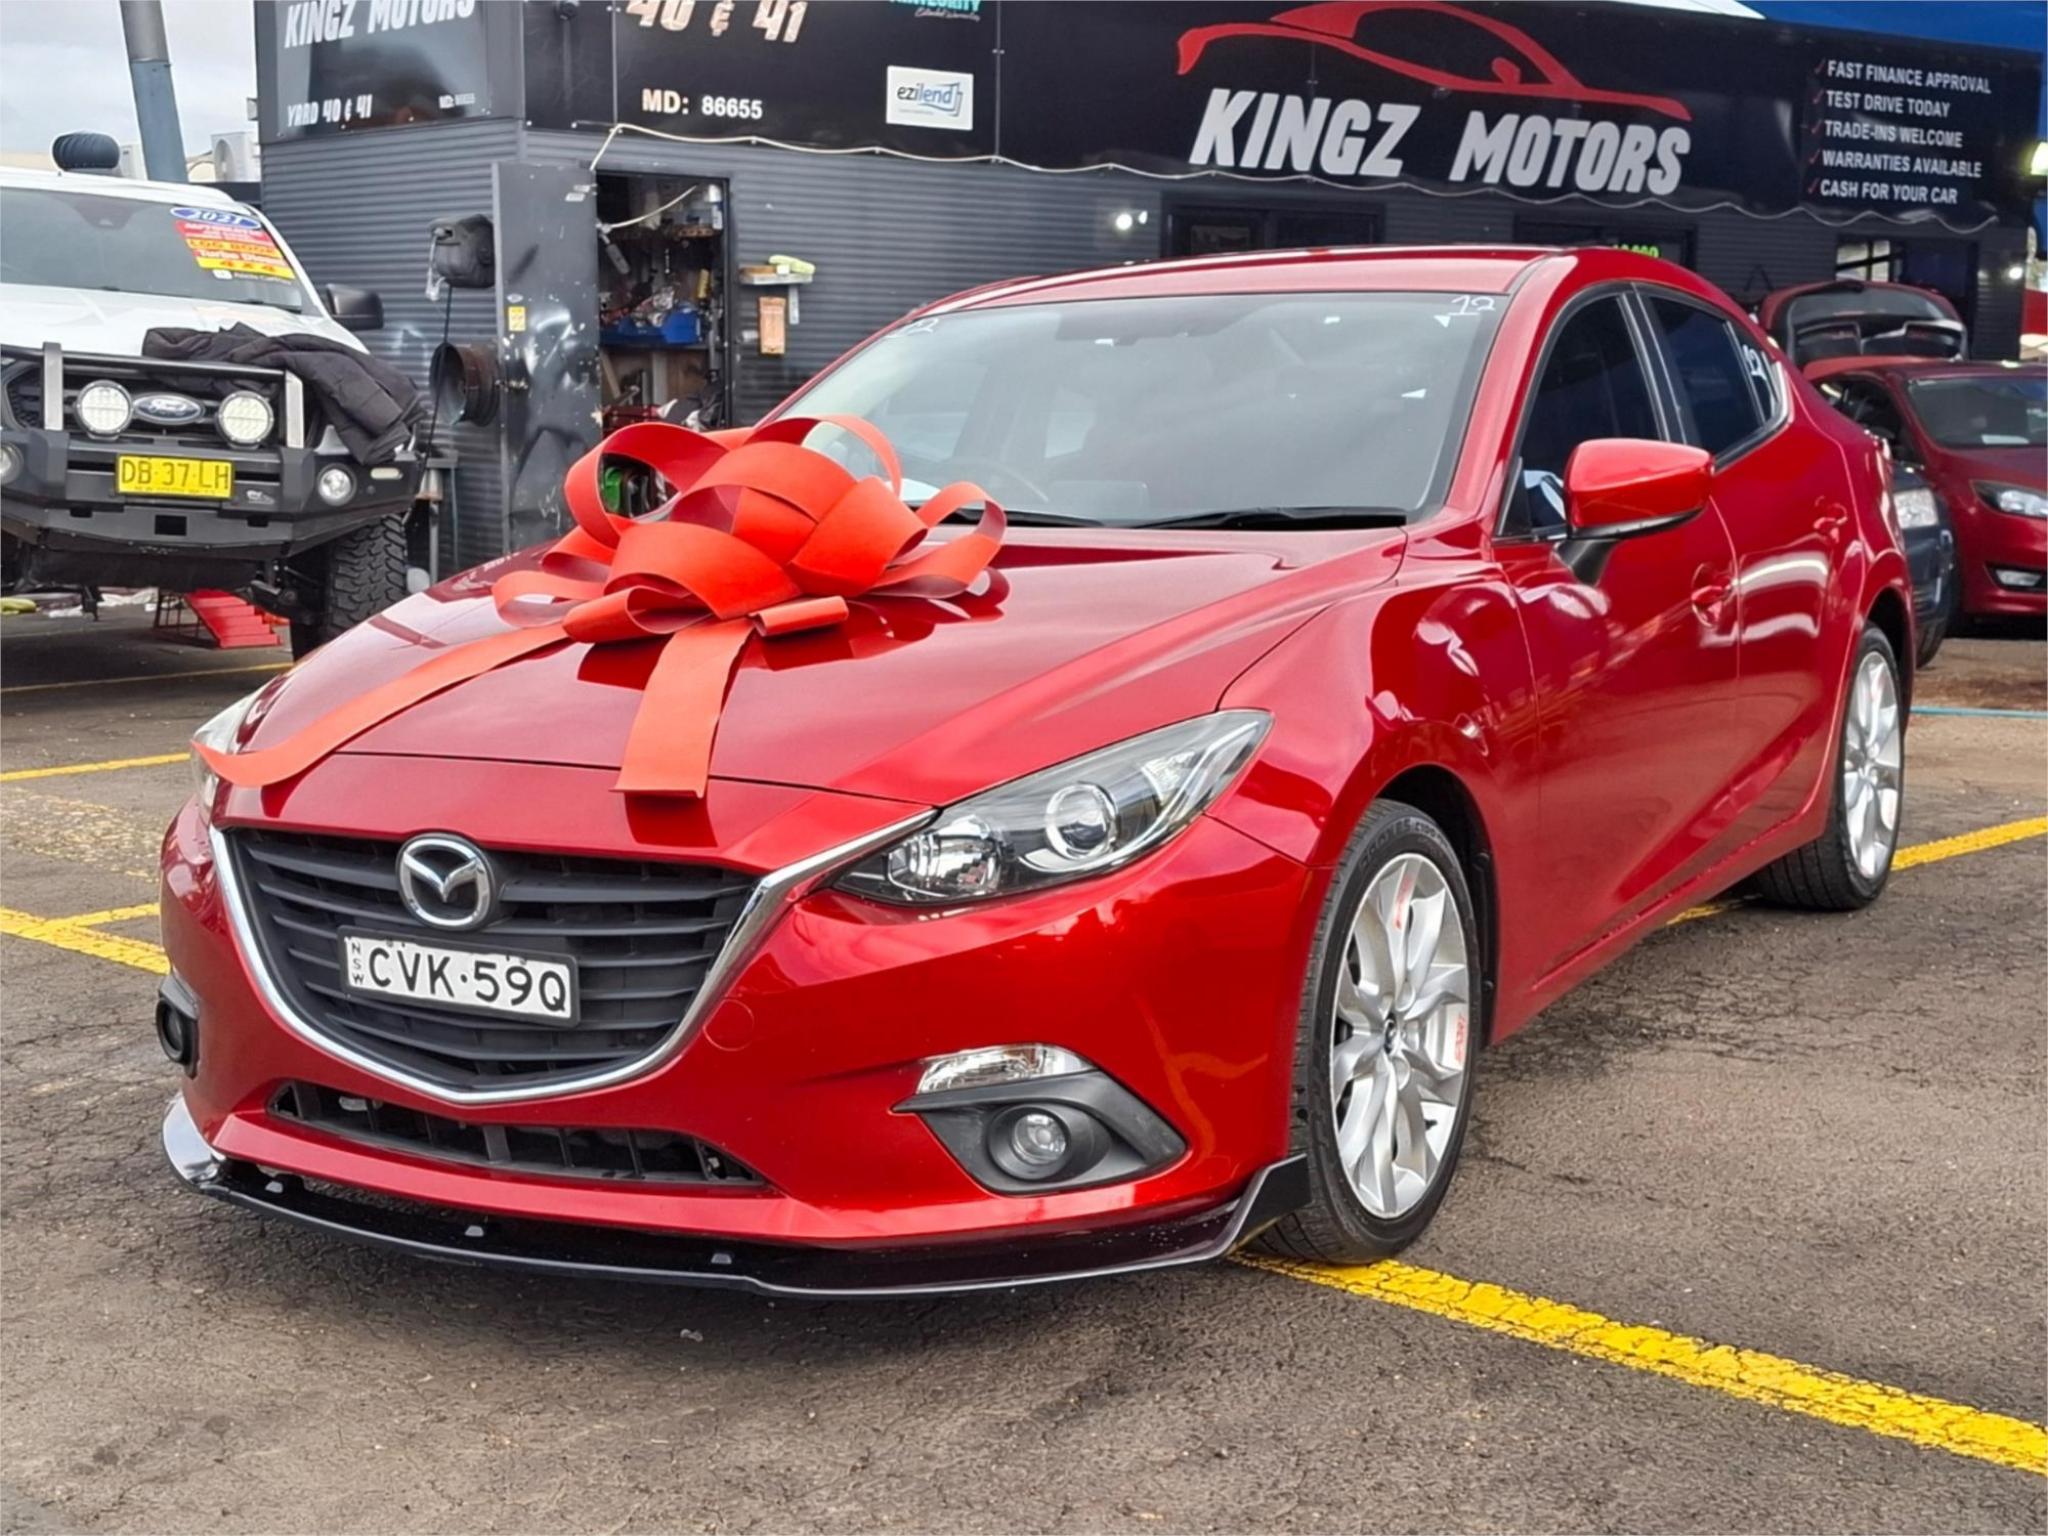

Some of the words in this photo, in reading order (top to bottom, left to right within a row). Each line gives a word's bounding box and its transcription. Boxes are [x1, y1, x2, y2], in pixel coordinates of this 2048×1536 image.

[284, 0, 355, 48] KINGZ
[625, 0, 697, 31] 40
[752, 0, 808, 43] 41
[1827, 60, 1864, 79] FAST
[1866, 65, 1923, 87] FINANCE
[1925, 72, 1991, 94] APPROVAL
[641, 88, 689, 115] MD:
[701, 95, 763, 120] 86655
[897, 83, 953, 104] ezilend
[1826, 90, 1861, 108] TEST
[1864, 94, 1903, 114] DRIVE
[1907, 98, 1950, 118] TODAY
[287, 101, 319, 127] YARD
[322, 98, 342, 123] 40
[356, 94, 373, 119] 41
[1188, 88, 1421, 177] KINGZ
[1448, 110, 1691, 196] MOTORS
[1824, 120, 1896, 143] TRADE-INS
[1898, 126, 1963, 148] WELCOME
[1822, 149, 1911, 172] WARRANTIES
[1913, 157, 1982, 178] AVAILABLE
[1820, 179, 1858, 198] CASH
[1861, 183, 1890, 199] FOR
[1892, 184, 1928, 202] YOUR
[1930, 187, 1958, 205] CAR
